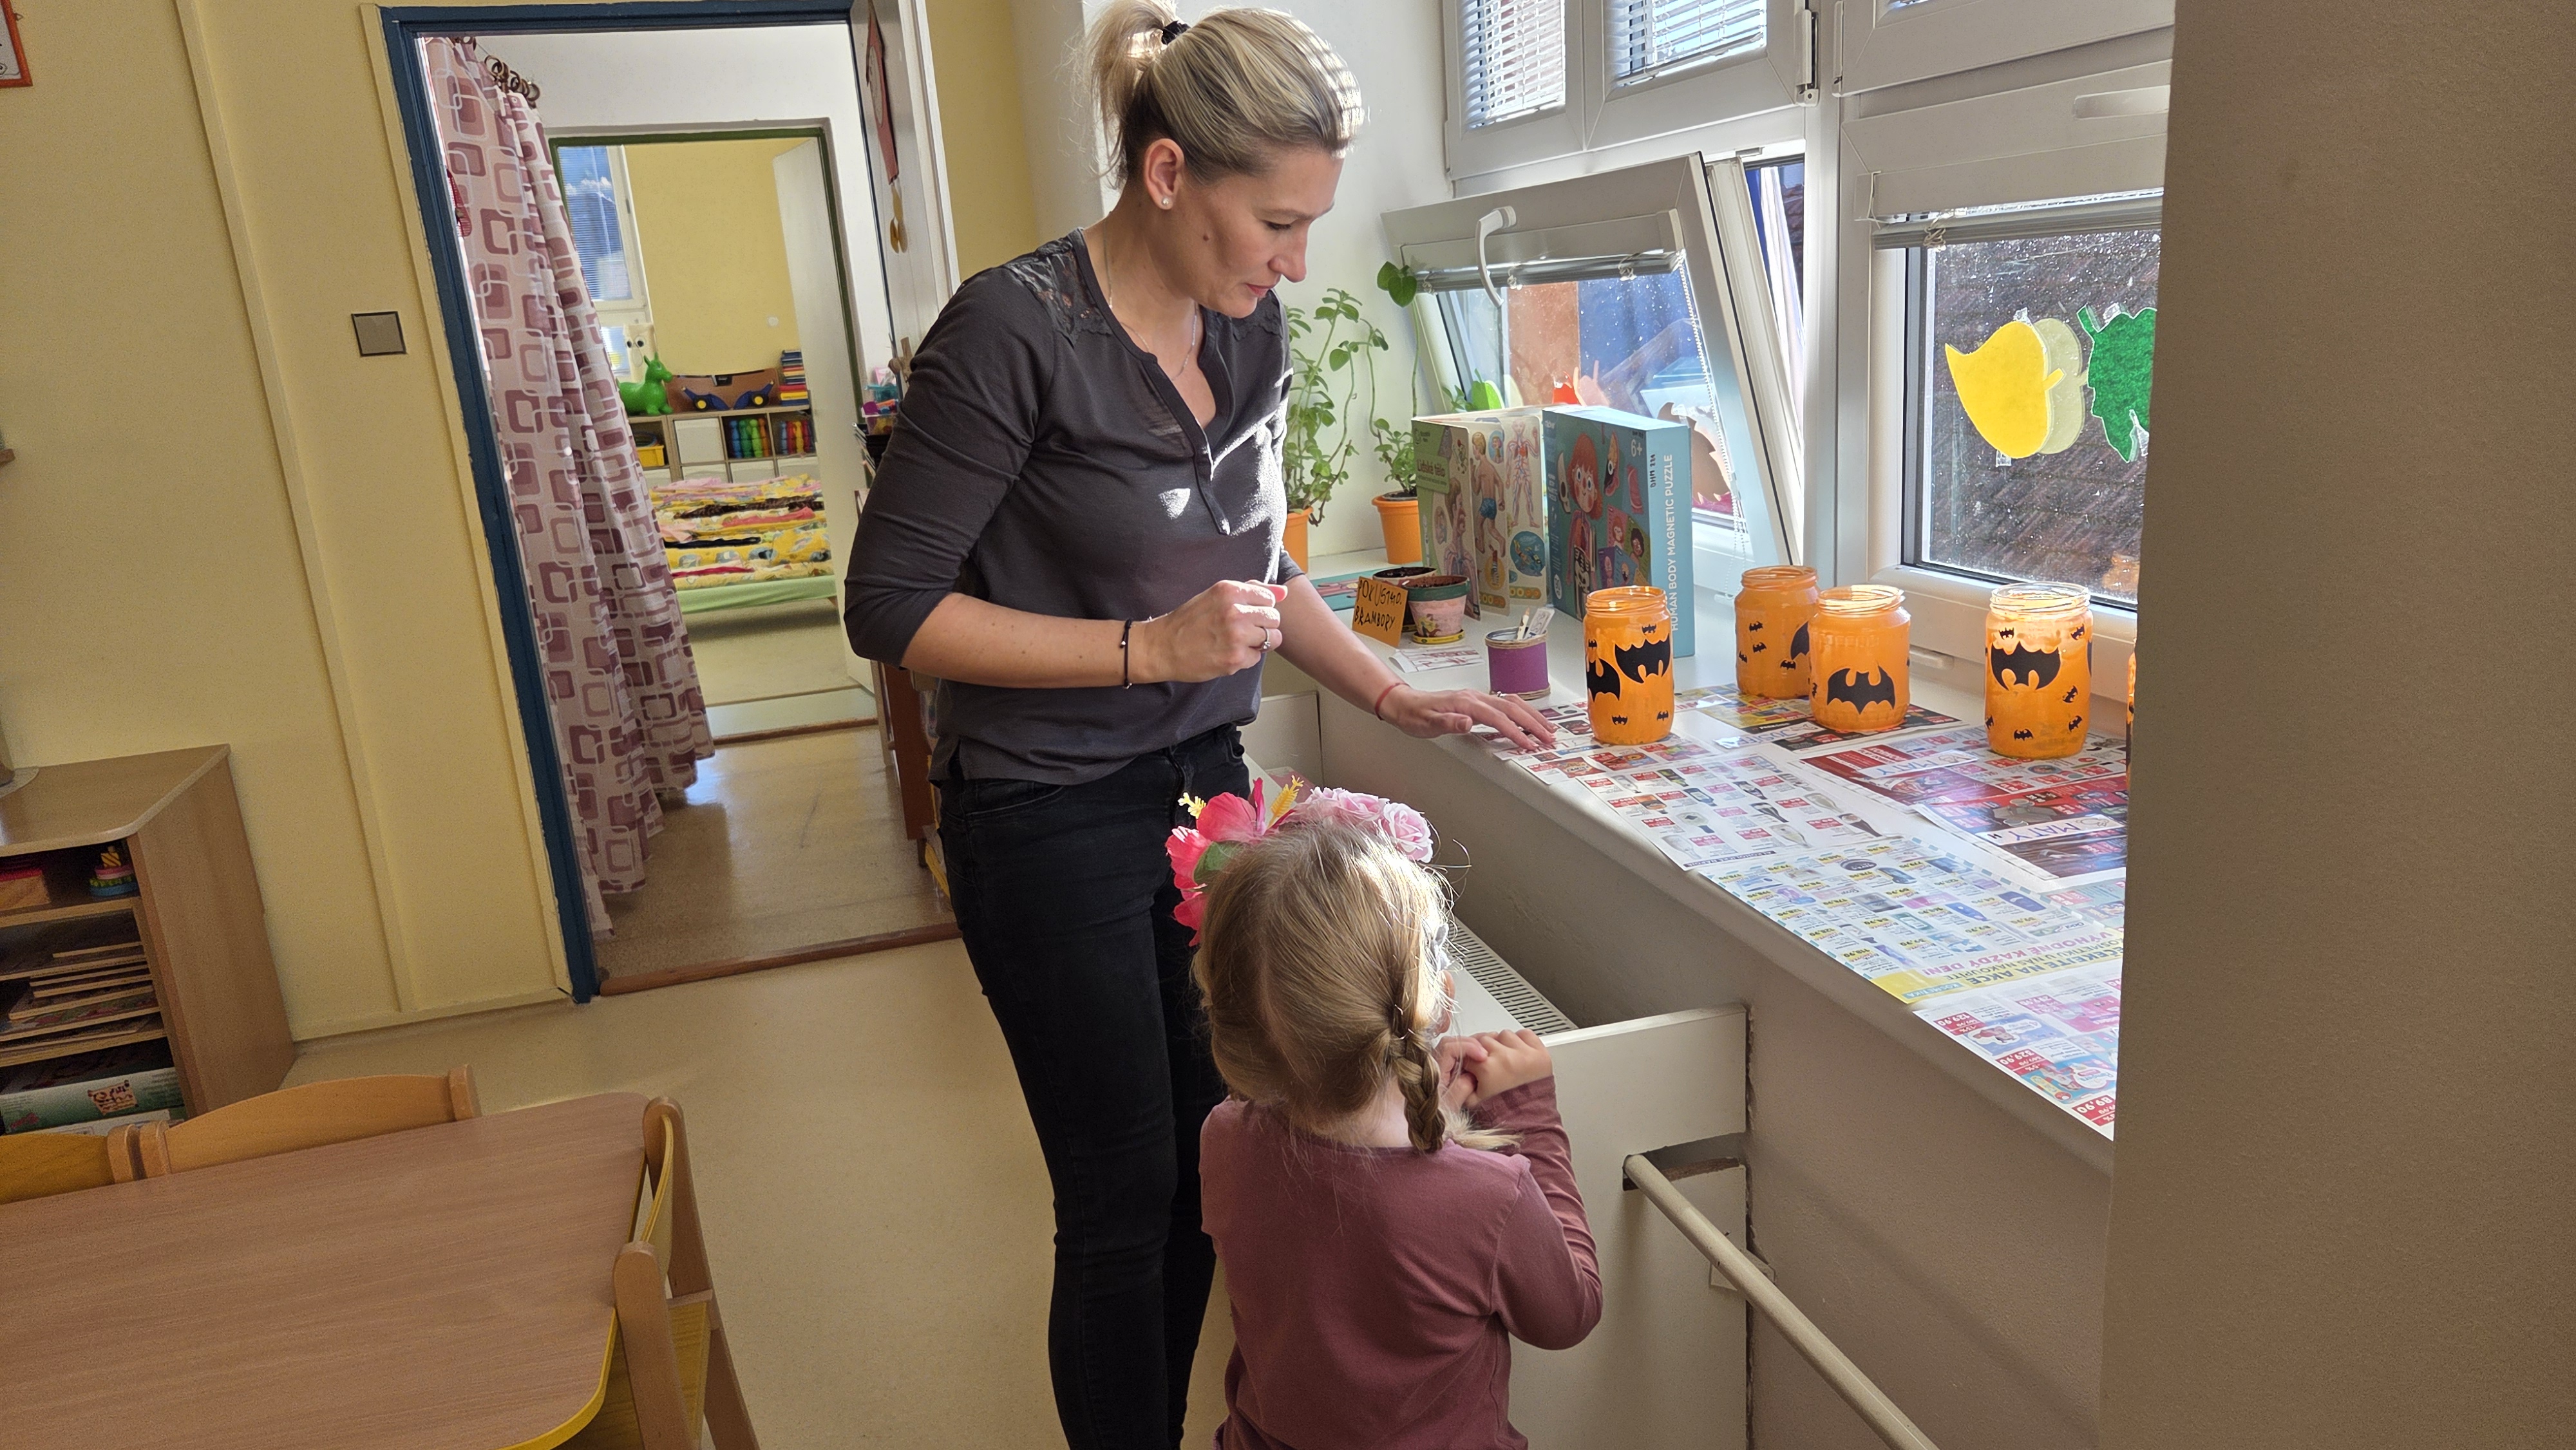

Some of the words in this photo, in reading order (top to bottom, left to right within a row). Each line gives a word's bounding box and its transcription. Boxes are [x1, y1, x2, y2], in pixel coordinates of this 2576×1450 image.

[1631, 439, 1642, 457] 6+
[1663, 454, 1674, 496] PUZZLE
[1665, 498, 1676, 556] MAGNETIC
[1667, 558, 1677, 589] BODY
[1354, 605, 1396, 632] BRAMBORY
[1669, 591, 1679, 632] HUMAN
[1877, 760, 1938, 775] MATY
[2008, 823, 2081, 841] MATY
[2027, 932, 2114, 956] VÝHODNĚ
[1969, 950, 2027, 968] KAŽDÝ
[2043, 947, 2123, 968] EČEKEJTE
[1922, 963, 1965, 975] DEN!
[1944, 963, 2017, 981] NAKOUPÍTE
[1966, 971, 2014, 984] AKCE
[2015, 965, 2045, 974] NA
[1907, 983, 1959, 997] KOSMETIKA
[1937, 1013, 1969, 1026] 129,90
[2000, 1050, 2034, 1066] 329,90
[2077, 1097, 2113, 1113] 89,90
